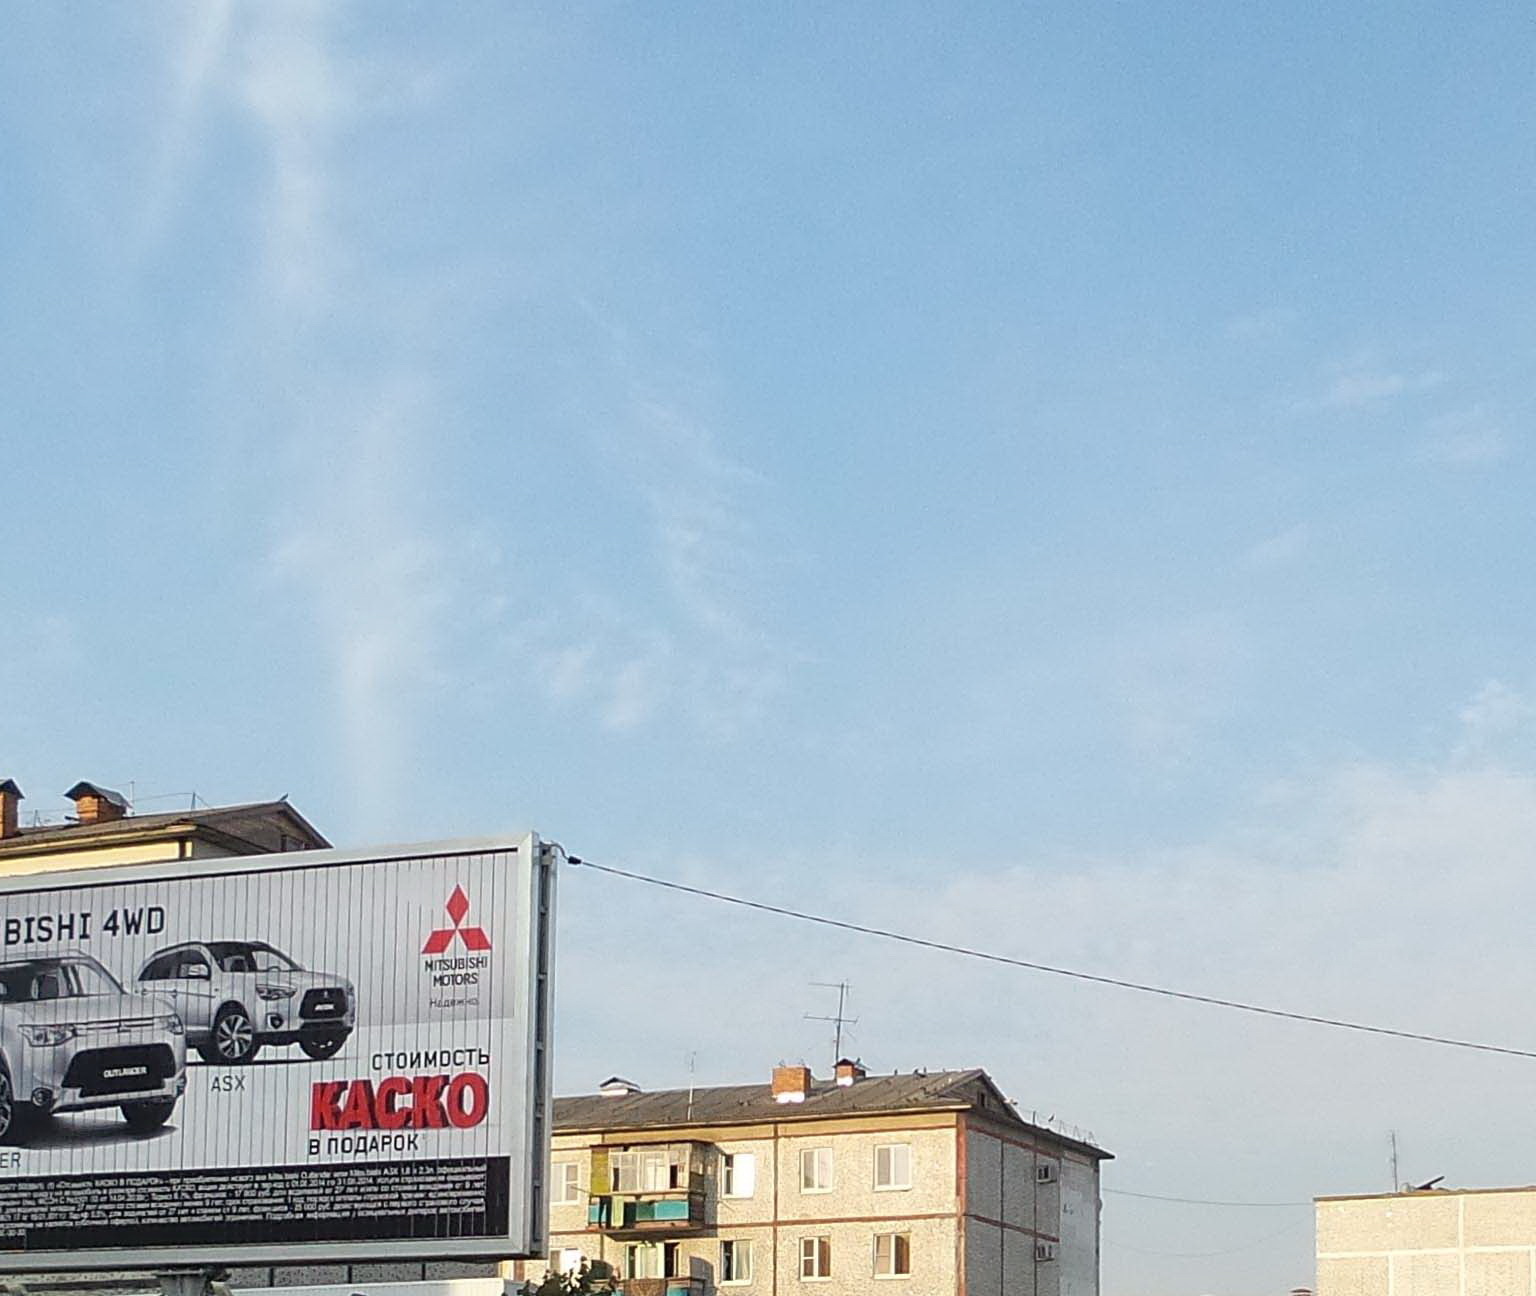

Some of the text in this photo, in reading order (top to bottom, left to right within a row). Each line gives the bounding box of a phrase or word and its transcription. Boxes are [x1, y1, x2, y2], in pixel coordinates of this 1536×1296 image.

[102, 906, 166, 937] 4WD
[425, 956, 488, 972] MITSUBISHI
[433, 972, 479, 988] MOTORS
[372, 1048, 490, 1071] СТОИМОСТЬ
[103, 1065, 148, 1078] OUTLANDER
[211, 1076, 246, 1092] ASX
[311, 1072, 491, 1131] КАСКО
[309, 1134, 419, 1156] В ПОДАРОК
